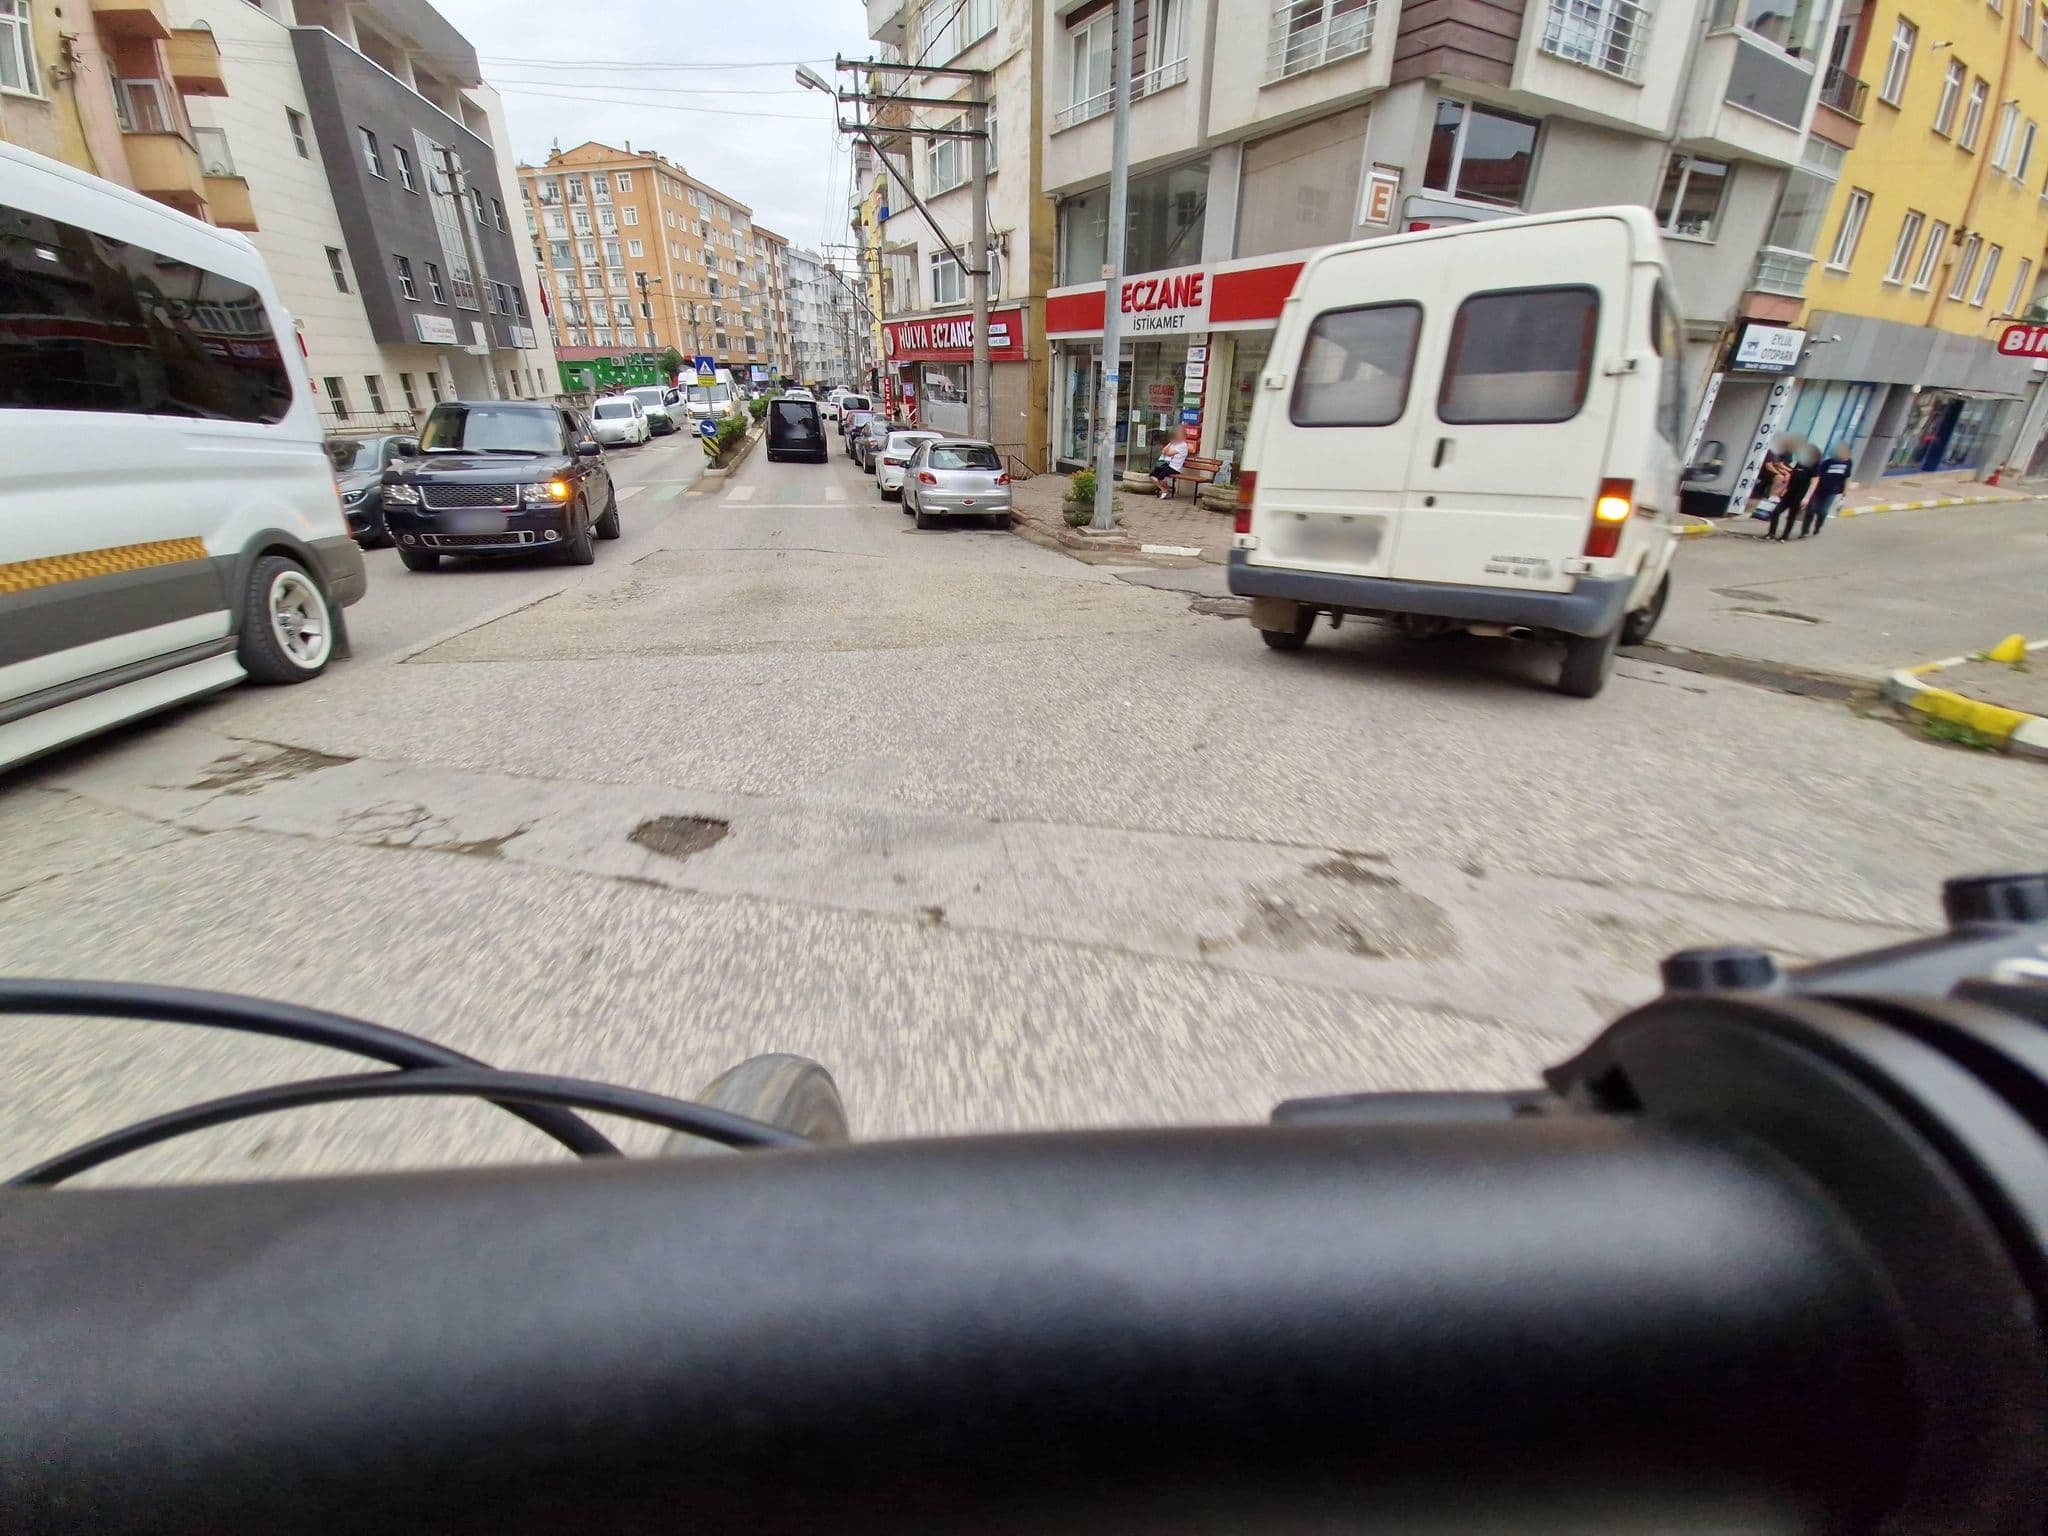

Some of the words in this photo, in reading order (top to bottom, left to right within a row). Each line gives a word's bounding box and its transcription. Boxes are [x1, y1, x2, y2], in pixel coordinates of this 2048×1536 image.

[1371, 185, 1390, 219] E
[1121, 272, 1204, 313] ECZANE
[898, 322, 928, 349] HÜLYA
[1133, 315, 1185, 331] İSTİKAMET
[1732, 384, 1785, 507] OTOPARK
